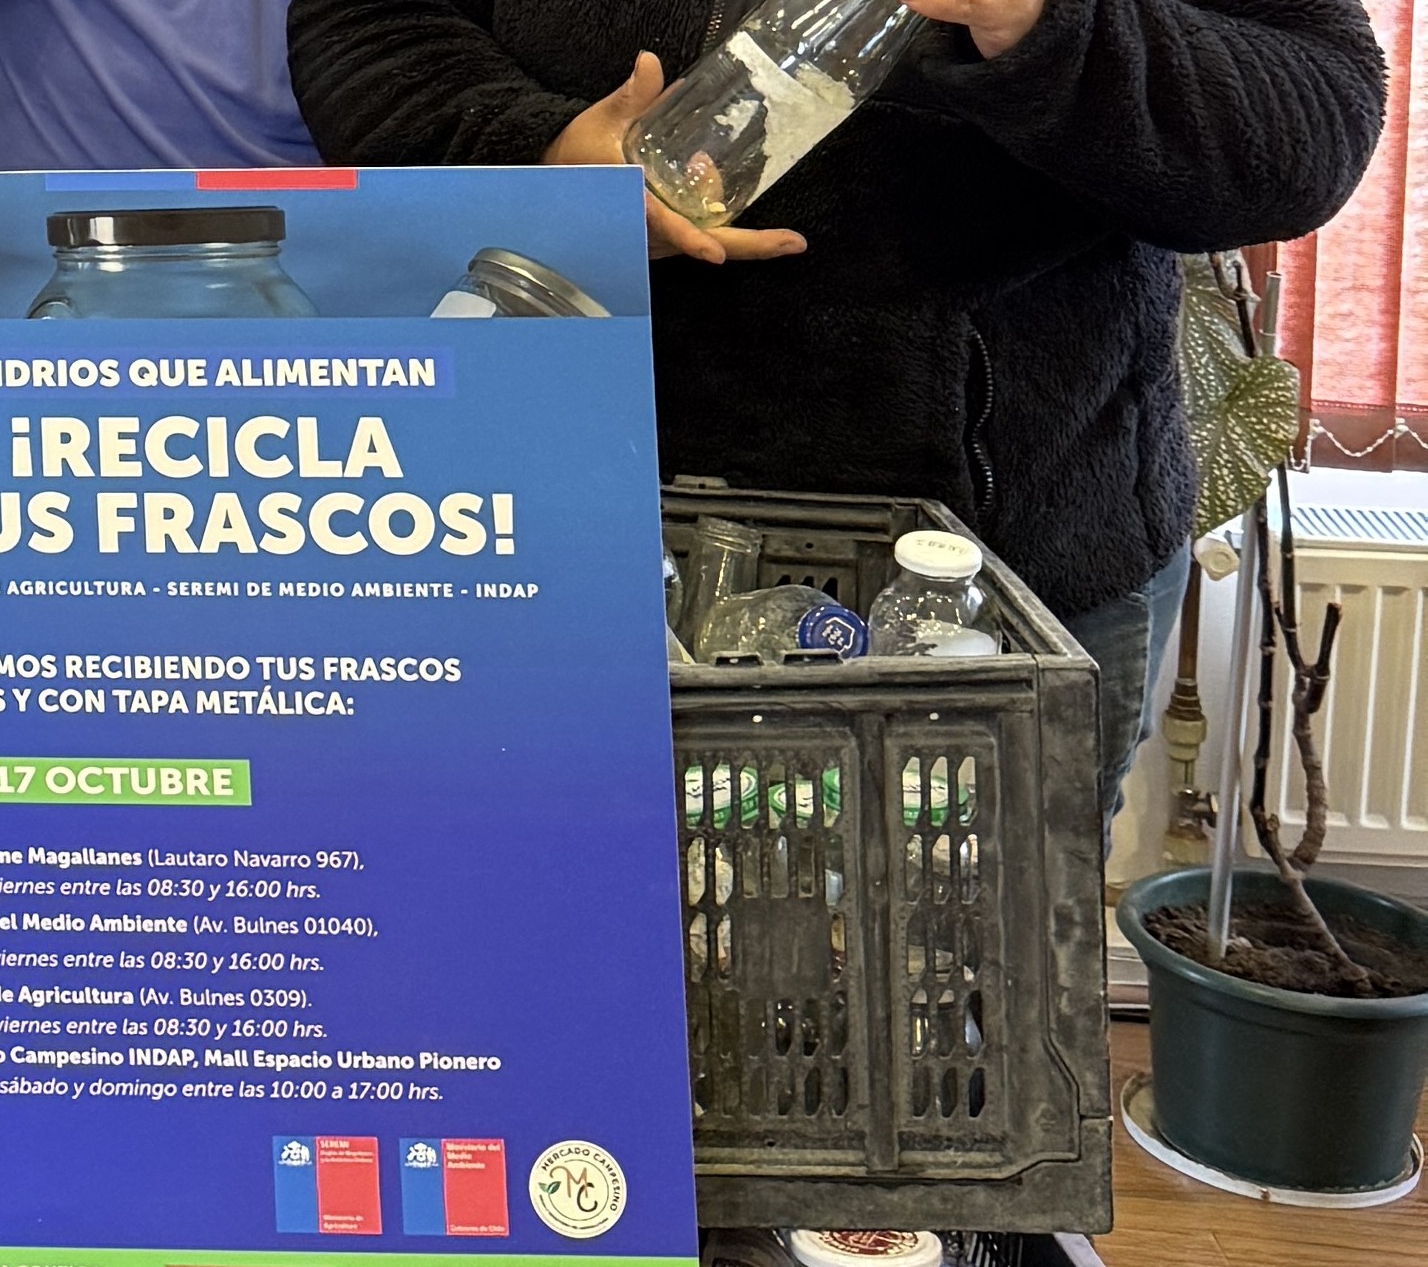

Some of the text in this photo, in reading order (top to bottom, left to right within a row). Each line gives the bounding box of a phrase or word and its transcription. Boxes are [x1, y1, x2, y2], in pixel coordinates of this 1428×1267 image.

[128, 358, 208, 387] QUE
[214, 358, 436, 387] ALIMENTAN
[11, 415, 404, 479] ¡RECICLA
[96, 491, 515, 556] FRASCOS!
[6, 580, 147, 596] AGRICULTURA
[167, 581, 239, 597] SEREMI
[246, 582, 273, 597] DE
[279, 582, 345, 597] MEDIO
[351, 582, 454, 598] AMBIENTE
[476, 583, 539, 598] INDAP
[65, 655, 250, 680] RECIBIENDO
[255, 656, 316, 681] TUS
[323, 657, 462, 682] FRASCOS
[11, 688, 32, 712] Y
[38, 688, 105, 713] CON
[111, 689, 190, 714] TAPA
[196, 686, 354, 716] METÁLICA:
[45, 766, 234, 796] OCTUBRE
[28, 846, 143, 869] Magallanes
[148, 848, 228, 868] (Lautaro
[233, 849, 311, 868] Navarro
[315, 851, 364, 870] 967),
[59, 880, 111, 896] entre
[116, 878, 142, 896] las
[147, 878, 205, 897] 08:30
[207, 884, 221, 902] y
[225, 879, 281, 898] 16:00
[286, 880, 321, 898] hrs.
[22, 913, 86, 932] Medio
[89, 914, 188, 933] Ambiente
[193, 915, 228, 935] (Av.
[233, 916, 299, 934] Bulnes
[304, 917, 378, 937] 01040),
[63, 952, 115, 968] entre
[119, 951, 145, 969] las
[150, 951, 208, 970] 08:30
[211, 956, 225, 974] y
[228, 952, 285, 971] 16:00
[289, 953, 324, 971] hrs.
[17, 985, 134, 1008] Agricultura
[139, 987, 174, 1007] (Av.
[179, 988, 245, 1007] Bulnes
[250, 988, 312, 1009] 0309).
[66, 1019, 118, 1035] entre
[122, 1018, 148, 1036] las
[153, 1018, 211, 1037] 08:30
[214, 1023, 228, 1041] y
[231, 1019, 288, 1038] 16:00
[292, 1020, 328, 1038] hrs.
[9, 1045, 124, 1069] Campesino
[128, 1047, 199, 1069] INDAP,
[204, 1049, 249, 1067] Mall
[253, 1049, 333, 1072] Espacio
[337, 1050, 415, 1070] Urbano
[419, 1052, 502, 1070] Pionero
[0, 1076, 69, 1095] sábado
[71, 1082, 85, 1100] y
[89, 1078, 178, 1101] domingo
[181, 1081, 234, 1098] entre
[238, 1080, 265, 1098] las
[270, 1080, 327, 1099] 10:00
[331, 1085, 343, 1100] a
[348, 1082, 404, 1100] 17:00
[408, 1082, 443, 1100] hrs.
[540, 1147, 622, 1212] MERCADO CAMPESINO
